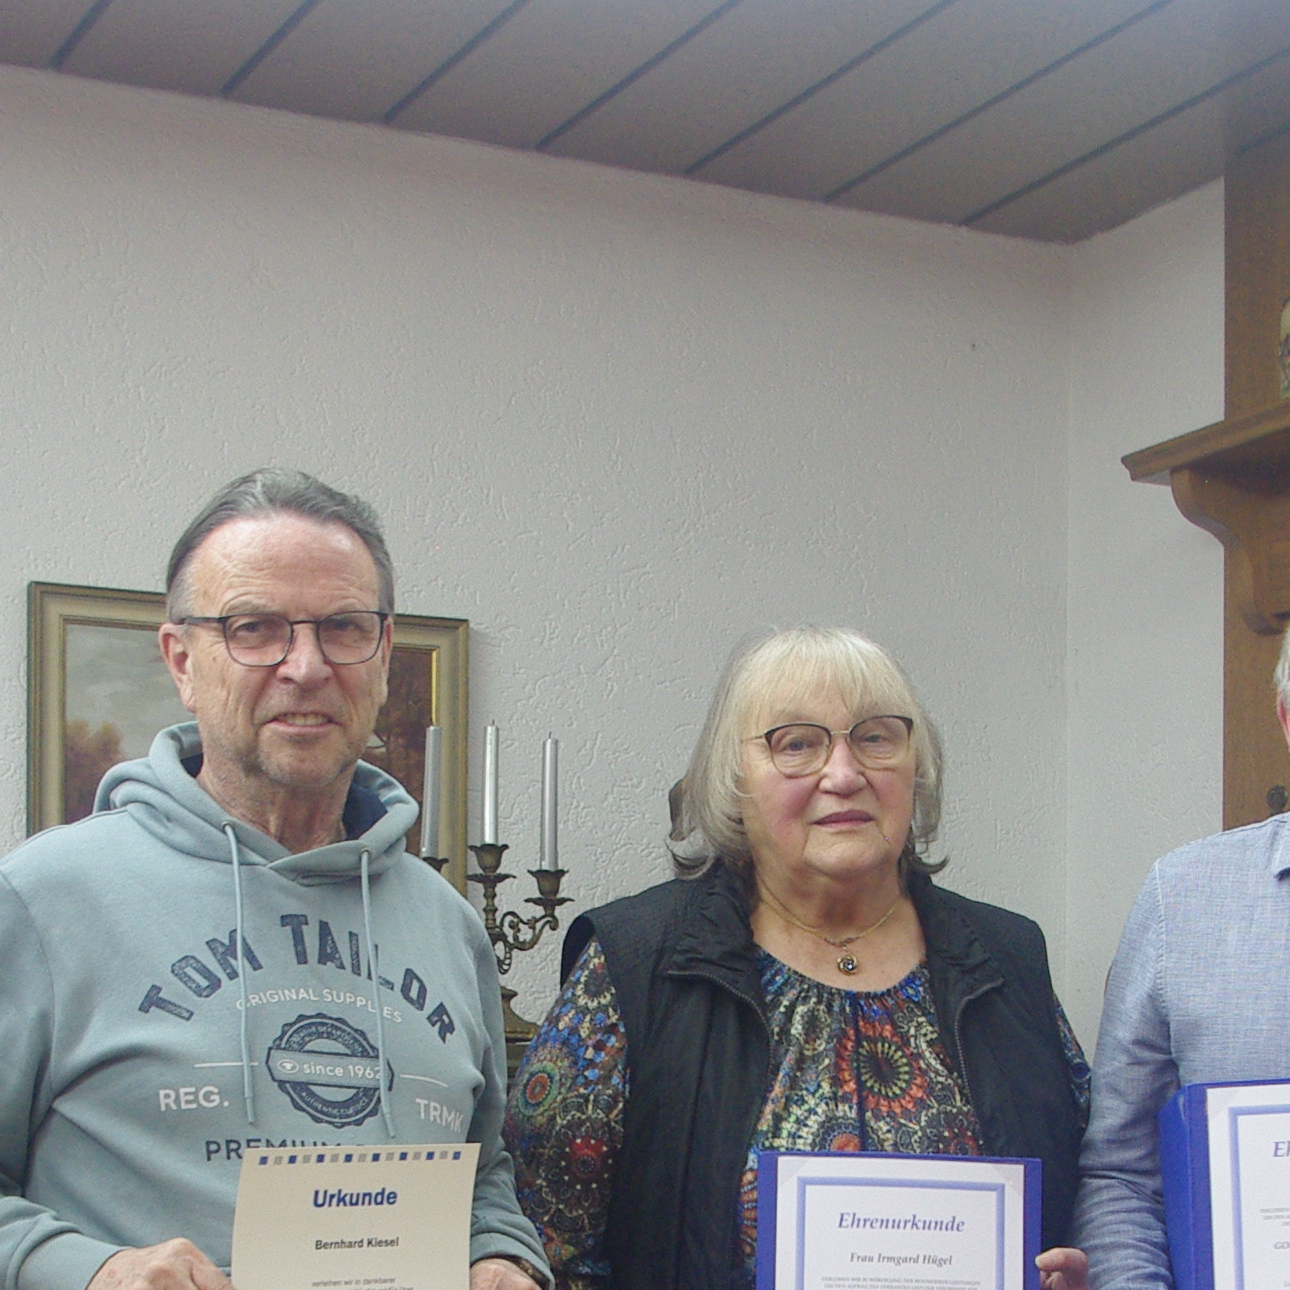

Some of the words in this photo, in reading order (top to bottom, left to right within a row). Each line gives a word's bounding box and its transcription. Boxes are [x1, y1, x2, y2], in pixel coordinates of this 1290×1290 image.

[138, 928, 263, 1021] TOM
[280, 913, 456, 1044] TAILOR
[322, 988, 402, 1023] SUPPLES
[303, 1062, 343, 1077] since
[348, 1065, 382, 1080] 1962
[158, 1086, 230, 1112] REG.
[415, 1098, 465, 1134] TRMK
[312, 1187, 398, 1208] Urkunde
[837, 1212, 965, 1232] Ehrenurkunde
[315, 1238, 364, 1250] Bernhard
[366, 1236, 400, 1249] Kiesel
[849, 1252, 874, 1263] Frau
[877, 1253, 919, 1266] Irmgard
[922, 1254, 953, 1267] Hügel
